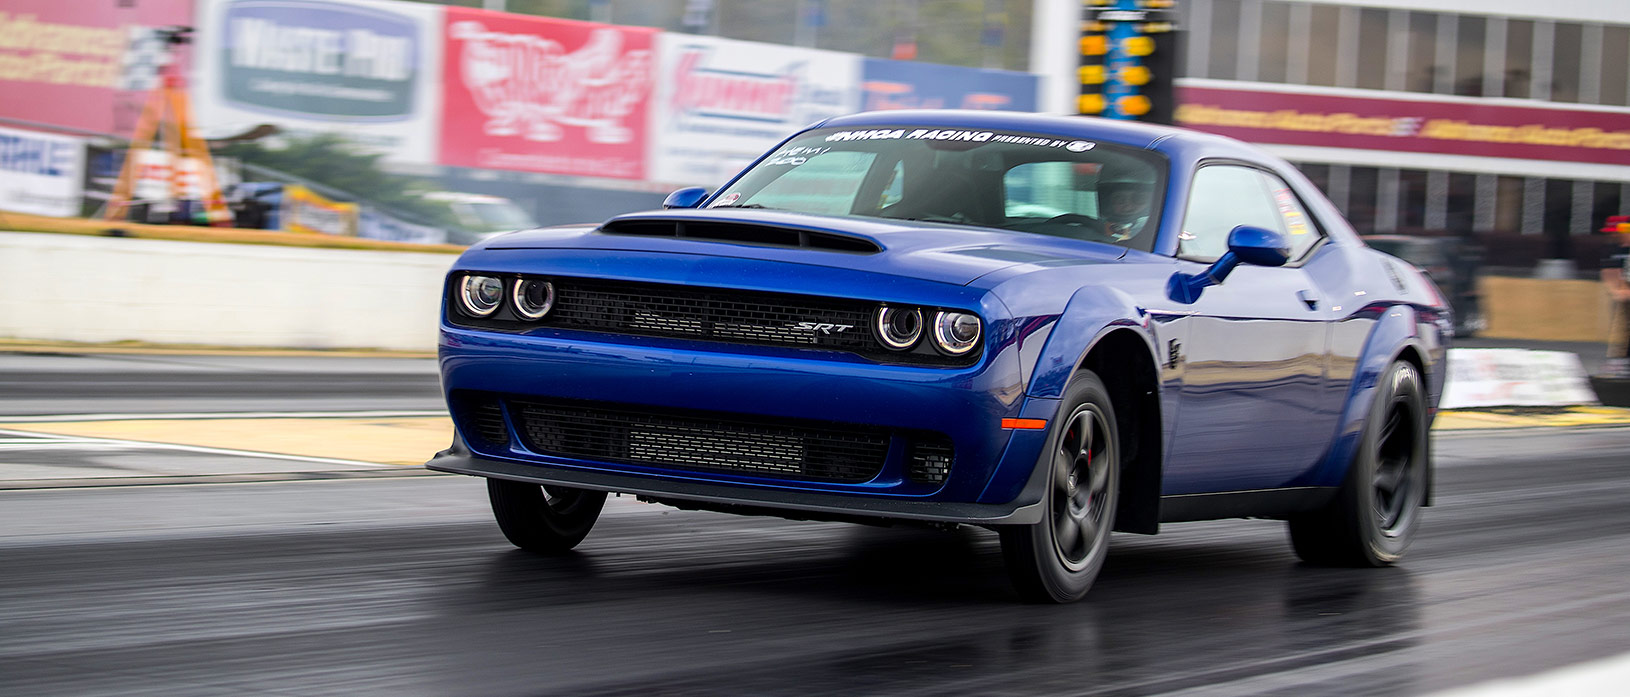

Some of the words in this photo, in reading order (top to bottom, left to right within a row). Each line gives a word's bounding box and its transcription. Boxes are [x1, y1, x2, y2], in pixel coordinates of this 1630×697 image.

[906, 129, 994, 142] RACING
[991, 134, 1050, 147] PRESENTED
[1049, 139, 1068, 149] BY
[793, 322, 854, 335] SRT
